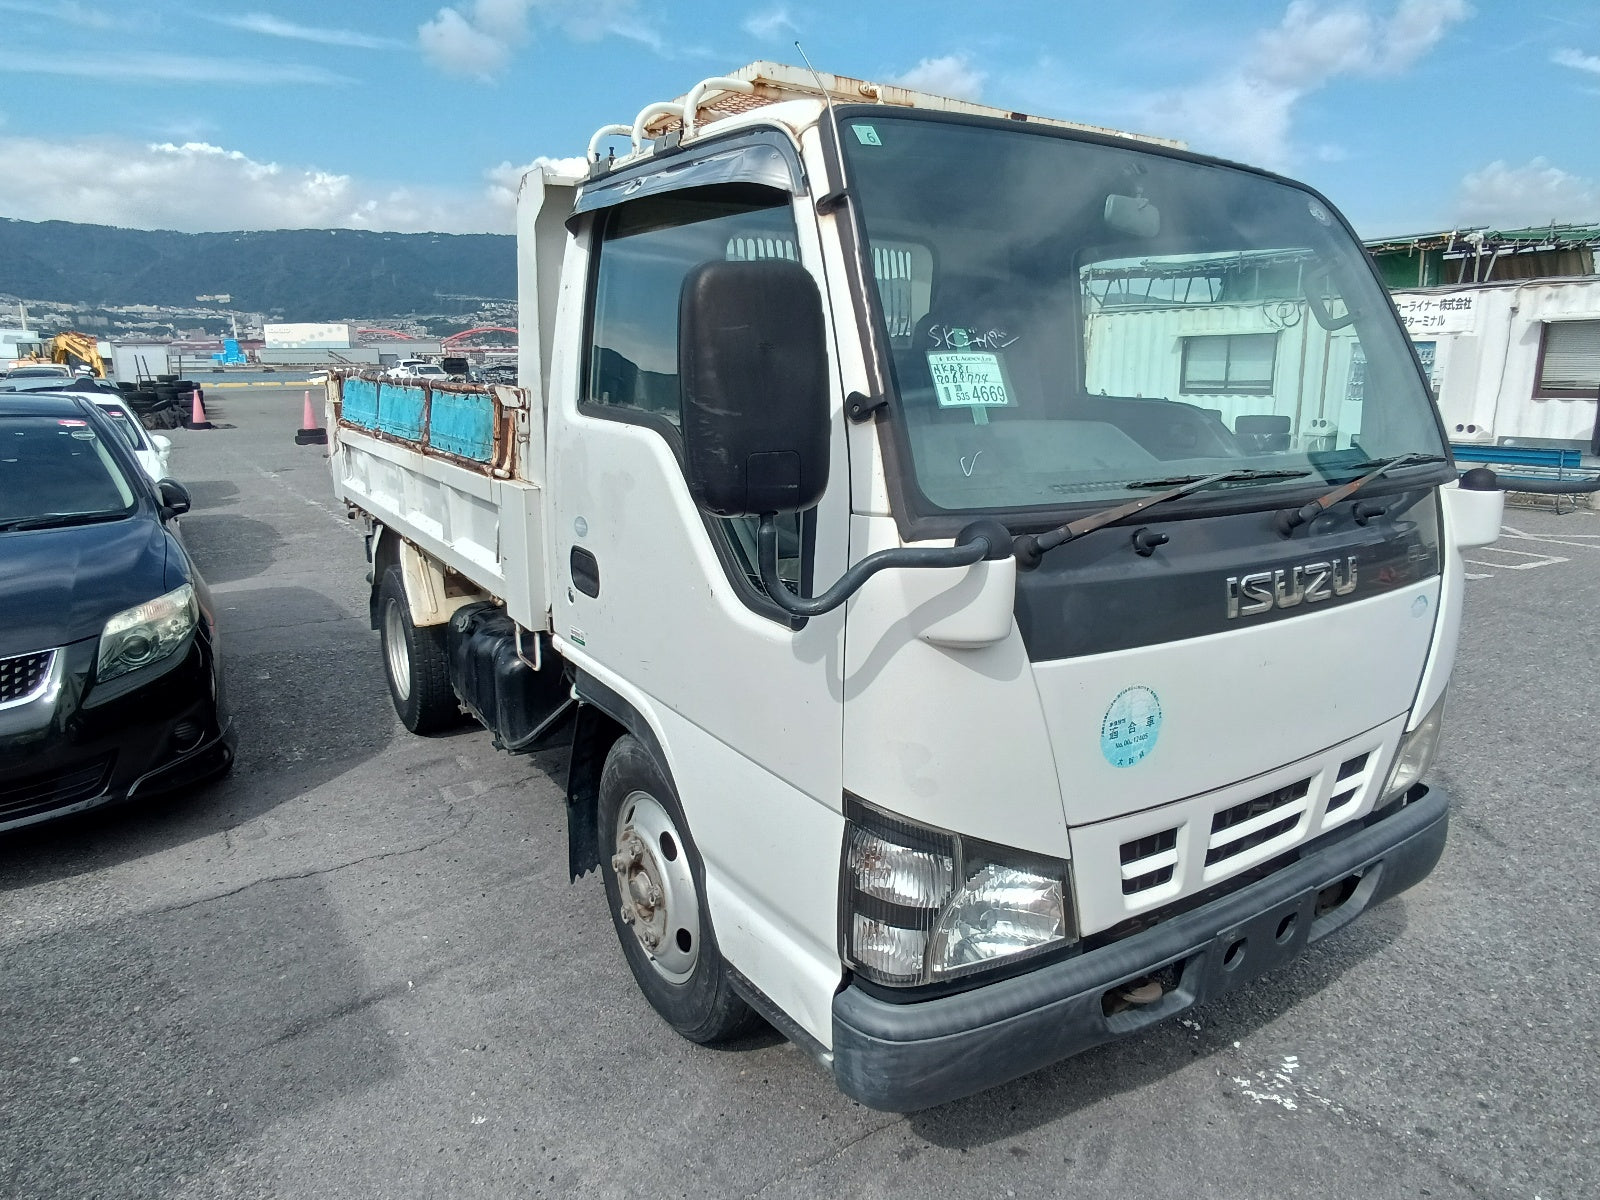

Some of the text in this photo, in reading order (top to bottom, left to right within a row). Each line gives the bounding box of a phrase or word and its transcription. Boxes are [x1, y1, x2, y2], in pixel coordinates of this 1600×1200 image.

[956, 391, 970, 401] 535
[972, 385, 1005, 402] 4669
[1226, 556, 1358, 619] ISUZU
